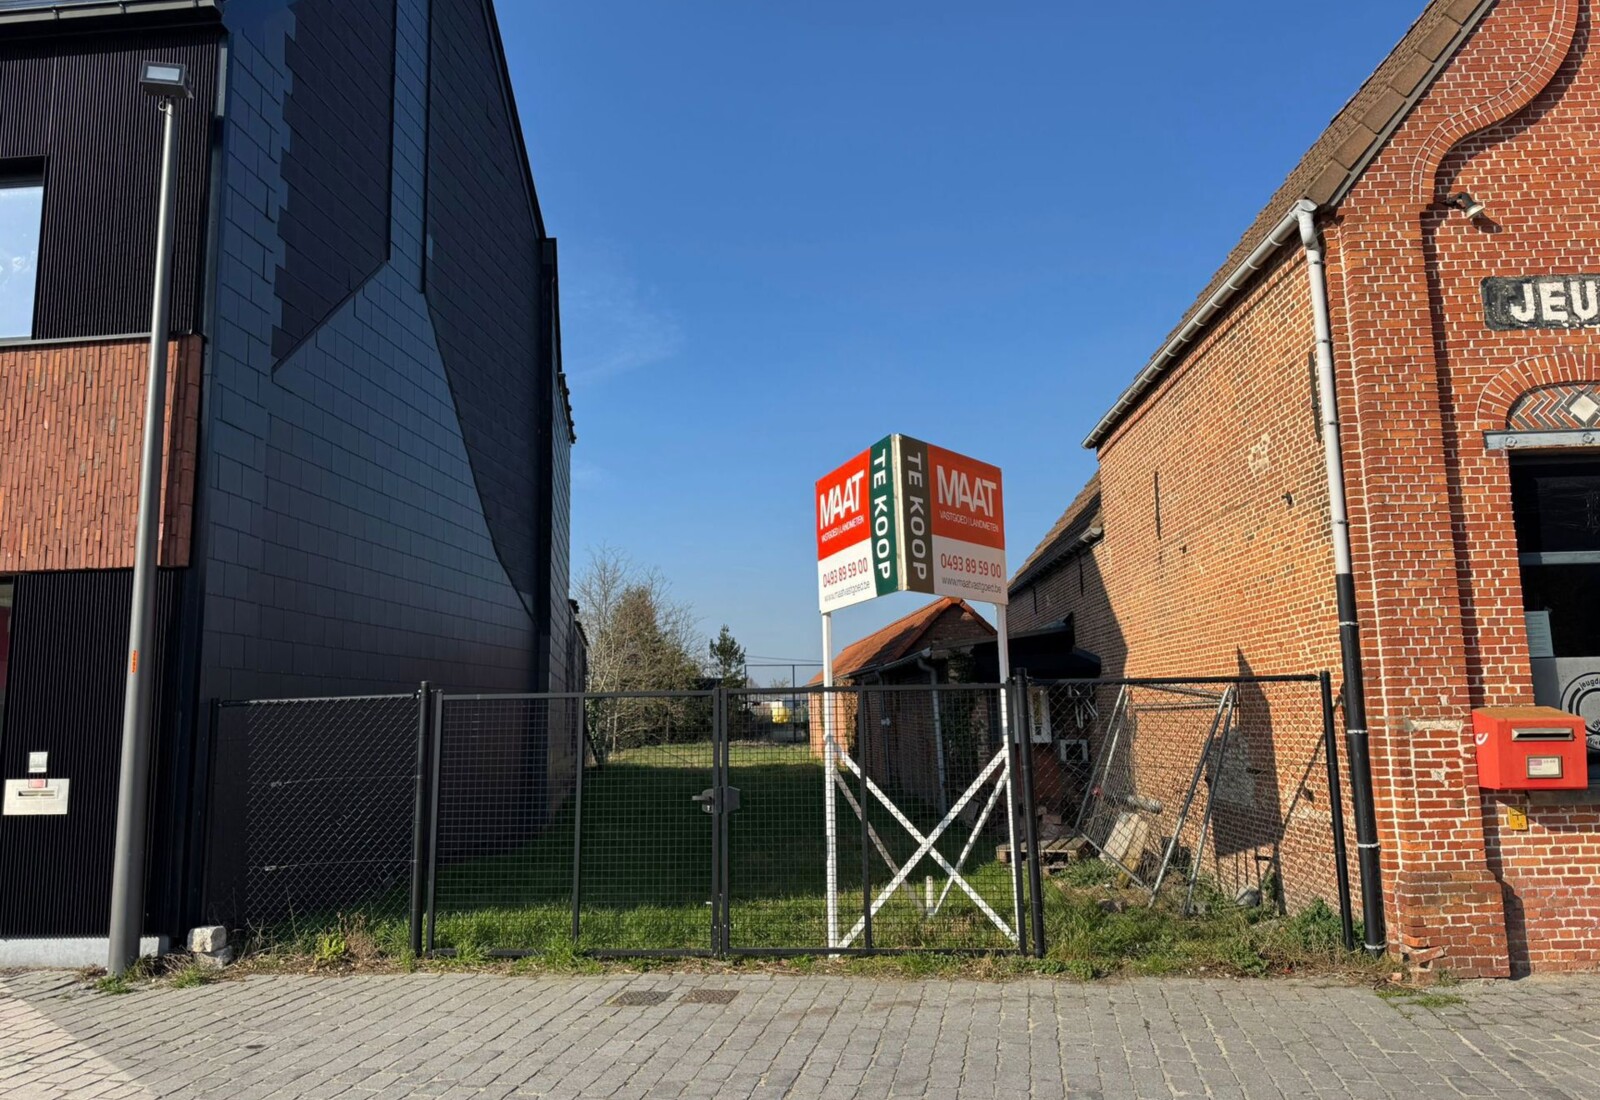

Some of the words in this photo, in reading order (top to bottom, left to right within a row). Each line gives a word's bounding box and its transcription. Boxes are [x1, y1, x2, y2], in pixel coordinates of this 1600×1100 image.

[873, 448, 886, 489] TE
[907, 452, 923, 488] TE
[820, 469, 865, 530] MAAT
[936, 465, 998, 518] MAAT
[874, 495, 891, 580] KOOP
[909, 495, 927, 580] KOOP
[939, 510, 967, 525] VASTGOED
[971, 518, 999, 533] LANDMETEN
[823, 569, 838, 588] 0493
[839, 566, 847, 582] 89
[848, 562, 857, 578] 59
[858, 557, 869, 575] 00
[940, 553, 963, 572] 0493
[966, 558, 977, 574] 89
[979, 560, 989, 576] 59
[990, 563, 1002, 578] 00
[941, 577, 1002, 594] www.maatvastgoed.be
